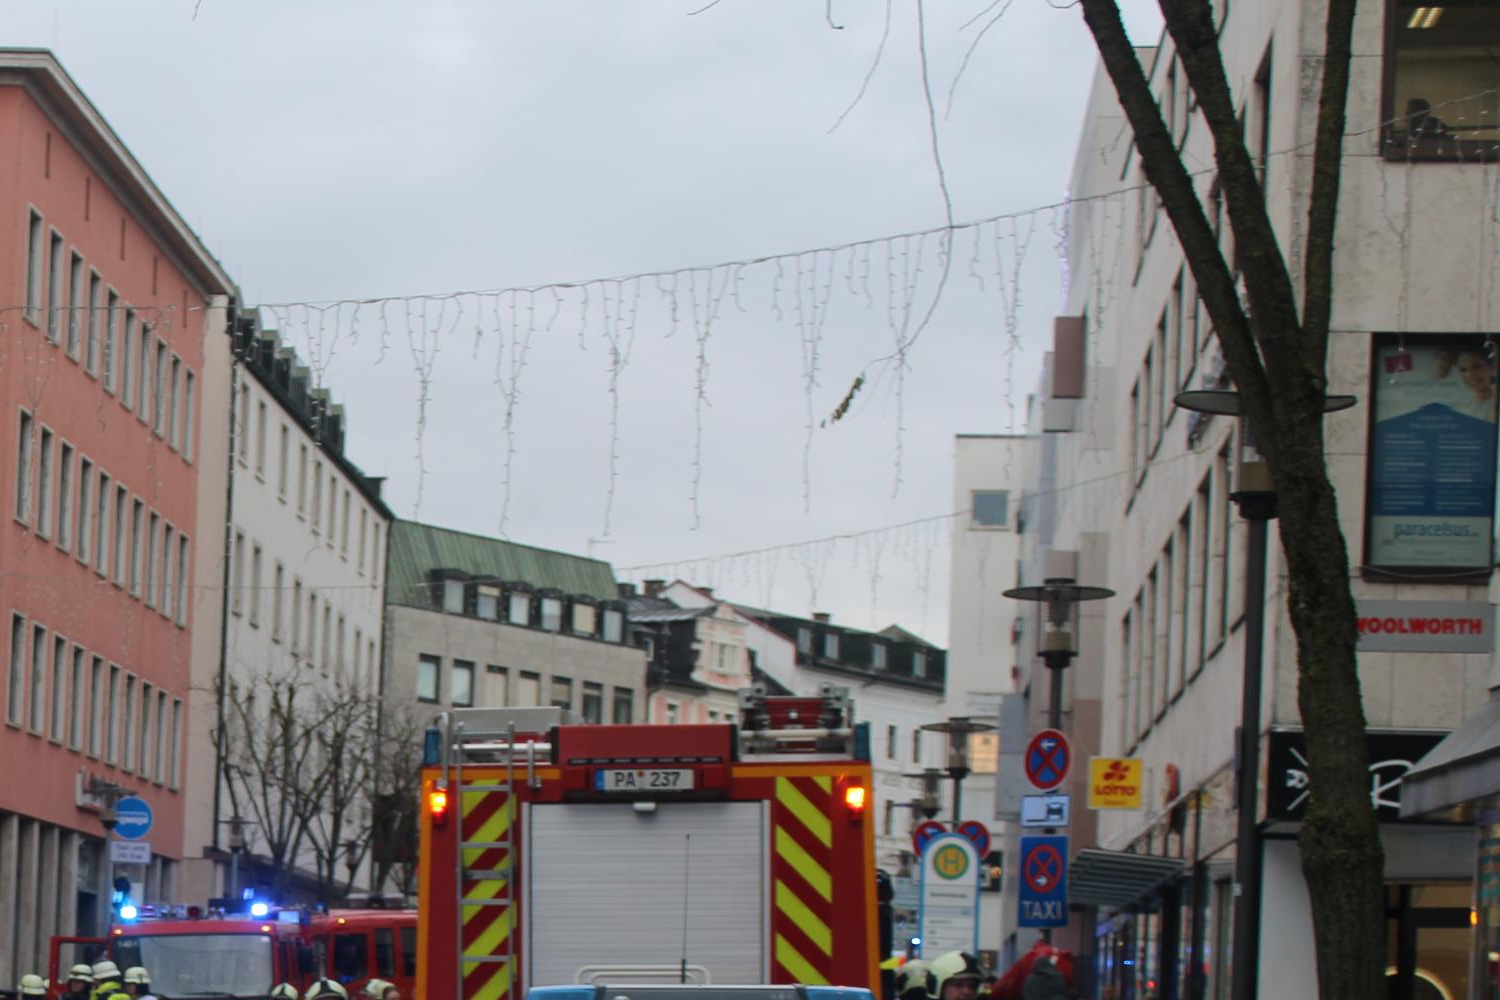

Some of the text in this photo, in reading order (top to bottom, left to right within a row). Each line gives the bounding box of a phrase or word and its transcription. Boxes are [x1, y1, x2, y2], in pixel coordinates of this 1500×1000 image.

[615, 772, 681, 787] PA 237
[1095, 786, 1135, 796] LOTTO
[945, 857, 960, 872] H
[1023, 901, 1061, 919] TAXI
